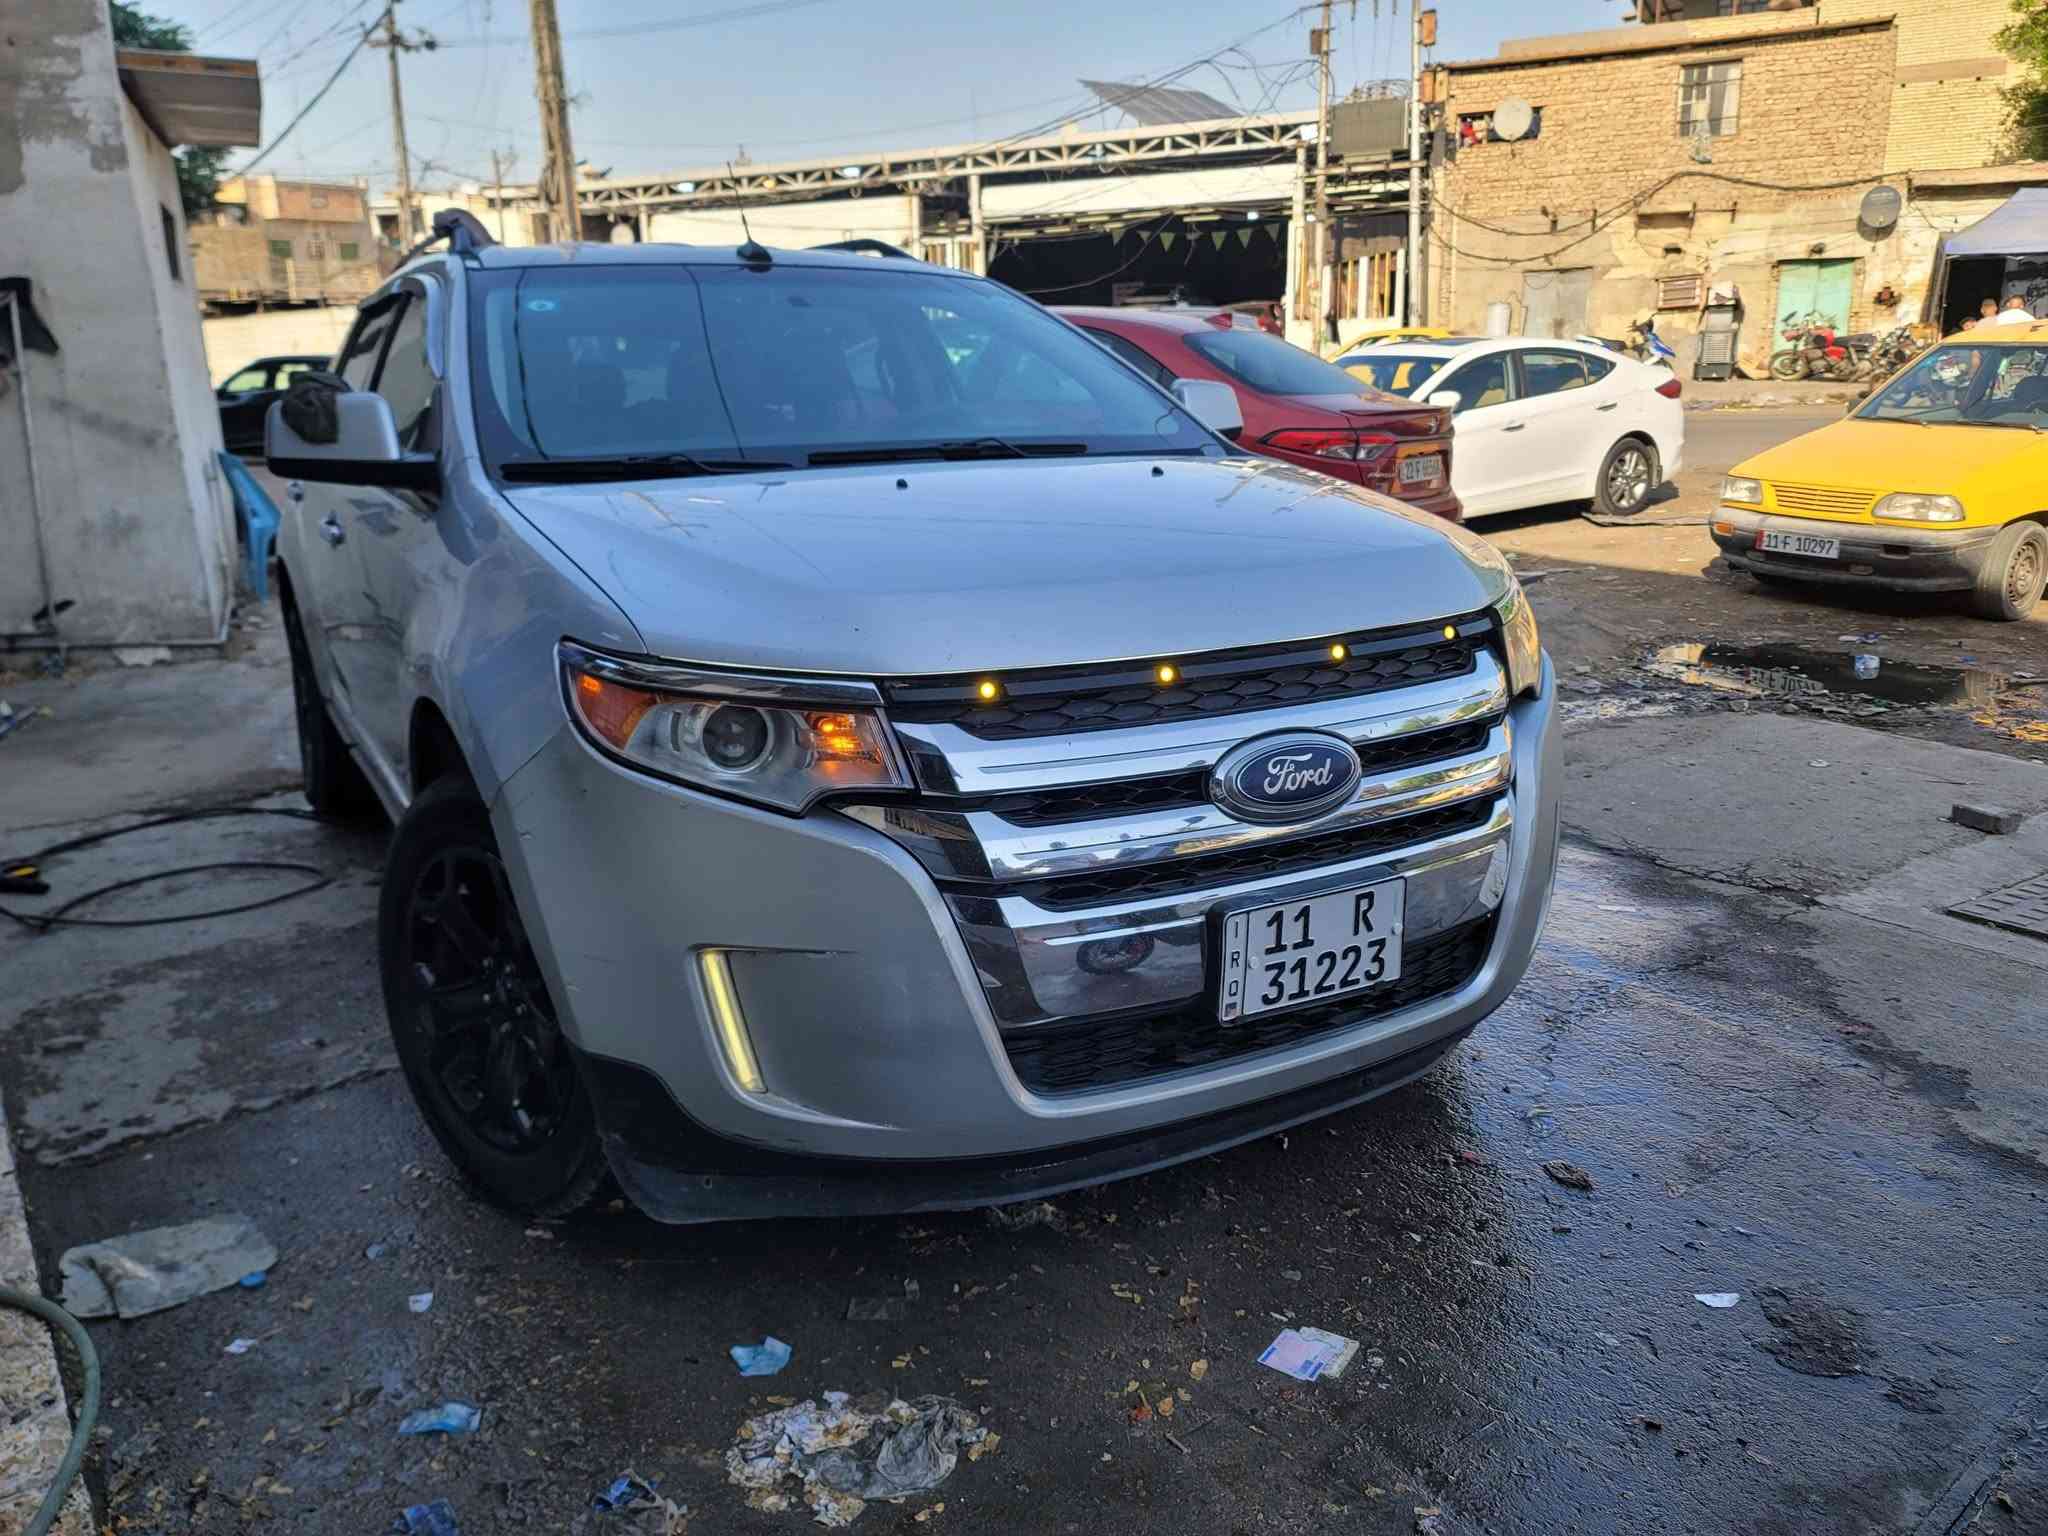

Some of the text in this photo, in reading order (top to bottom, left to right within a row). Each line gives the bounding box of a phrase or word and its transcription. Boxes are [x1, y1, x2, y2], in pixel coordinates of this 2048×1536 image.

[1766, 533, 1778, 548] 11
[1783, 535, 1792, 550] F
[1795, 537, 1834, 555] 10297
[1264, 753, 1333, 794] Ford
[1264, 890, 1376, 955] 11 R
[1261, 937, 1387, 1005] 31223
